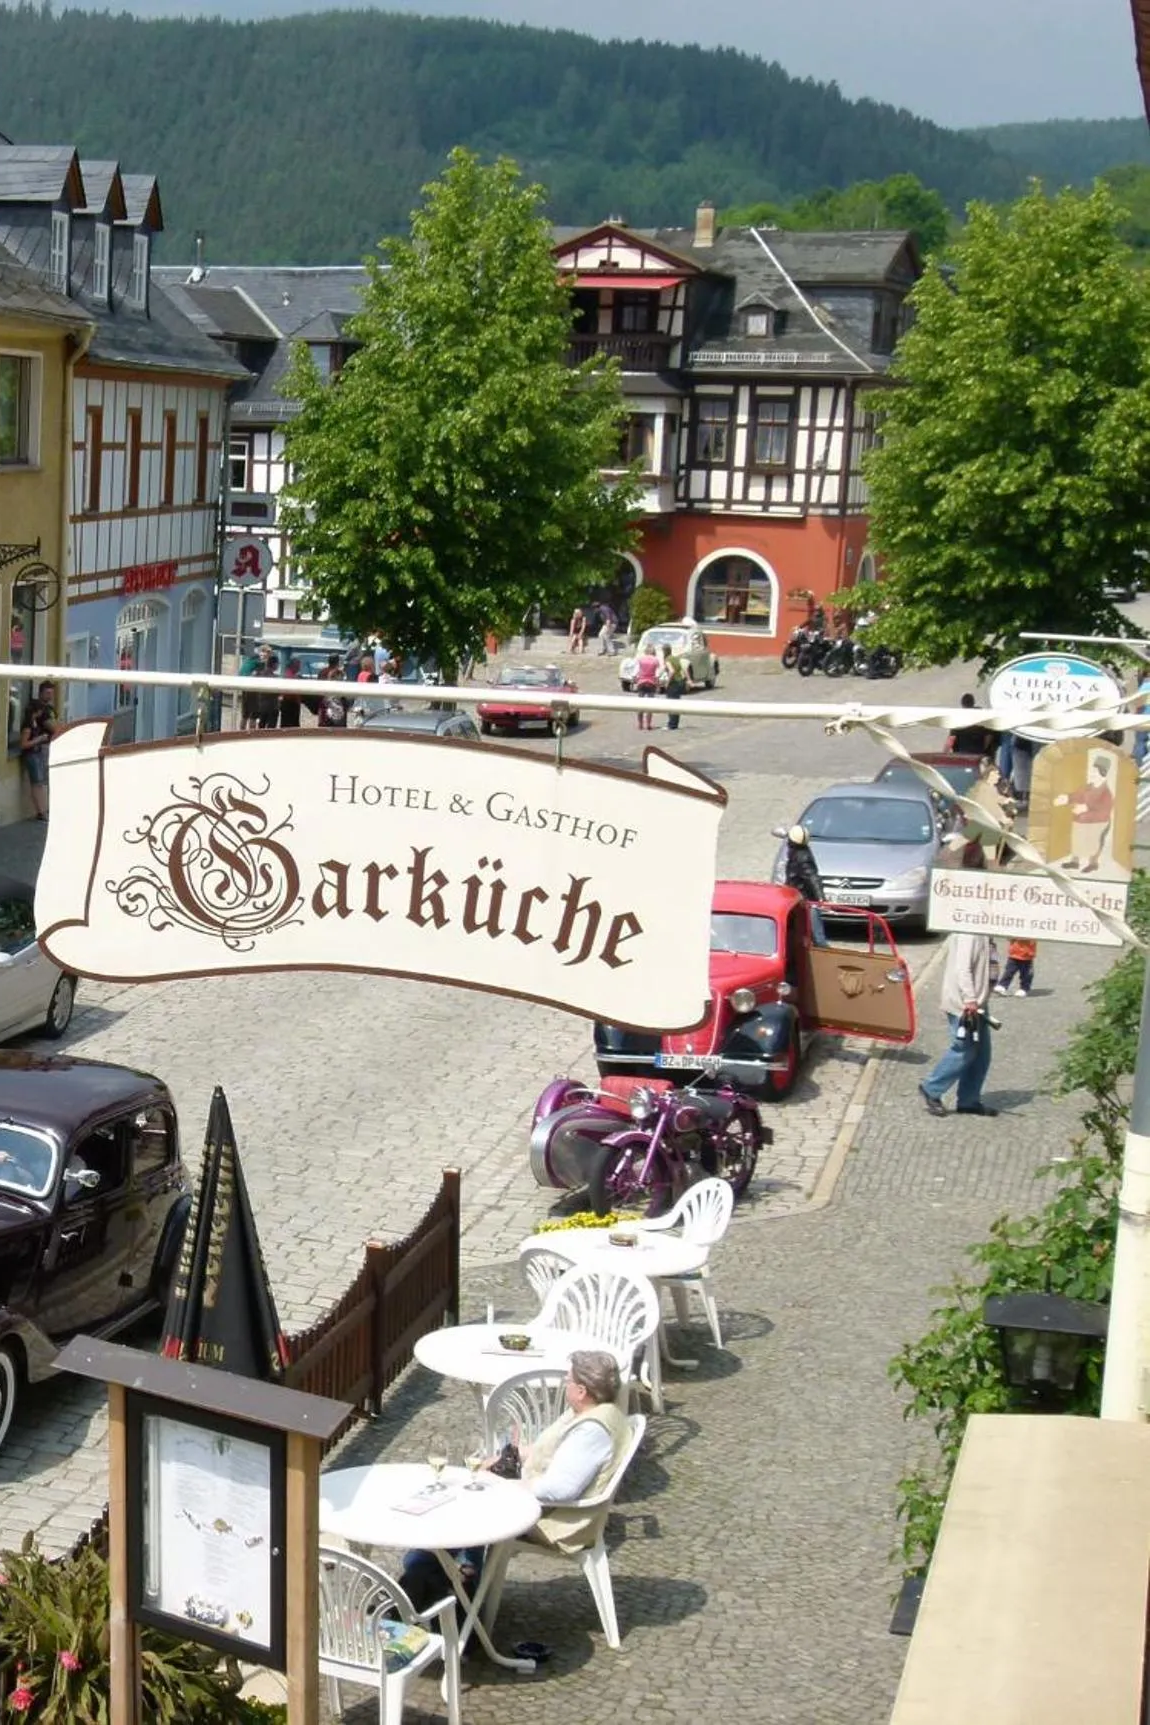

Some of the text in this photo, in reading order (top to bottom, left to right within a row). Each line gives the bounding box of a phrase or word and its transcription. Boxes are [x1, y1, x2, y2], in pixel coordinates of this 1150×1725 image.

[1012, 677, 1082, 690] UHREN
[328, 774, 638, 850] HOTEL & GASTHOF
[105, 772, 644, 969] Garküche
[933, 878, 1018, 902] Gasthof
[951, 908, 1101, 935] Tradition seit 1650
